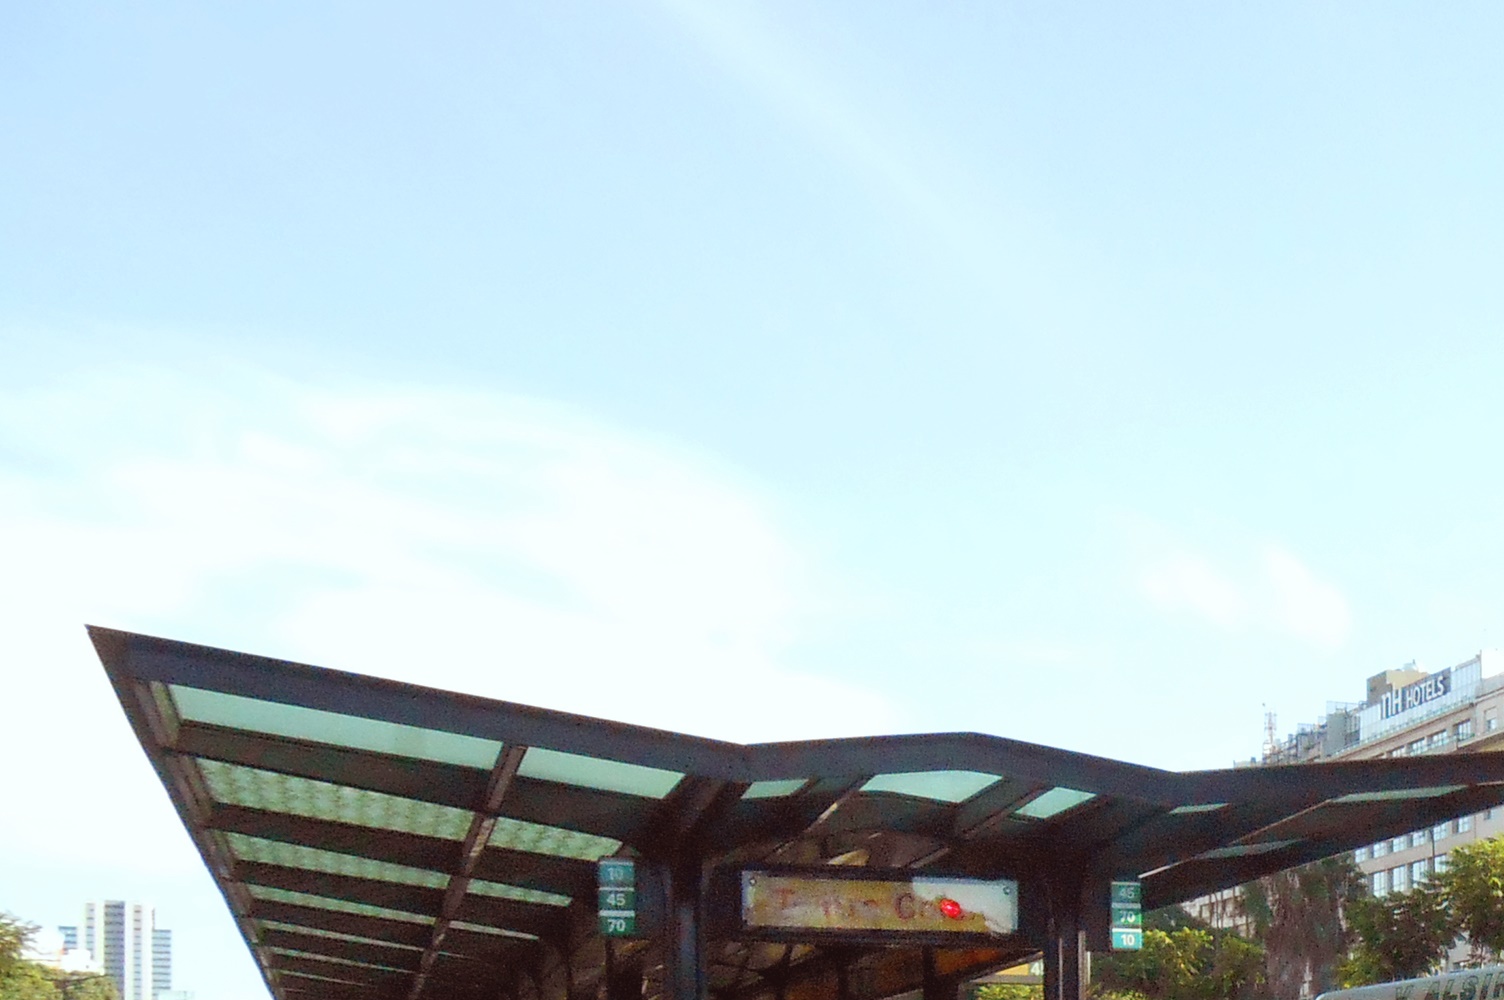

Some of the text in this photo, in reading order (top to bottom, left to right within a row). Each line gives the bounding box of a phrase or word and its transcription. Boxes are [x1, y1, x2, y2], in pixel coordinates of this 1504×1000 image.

[1406, 675, 1445, 709] HOTELS
[608, 867, 624, 880] 10
[606, 893, 626, 906] 45
[1120, 910, 1136, 923] 70
[608, 919, 626, 932] 70
[1121, 934, 1135, 946] 10
